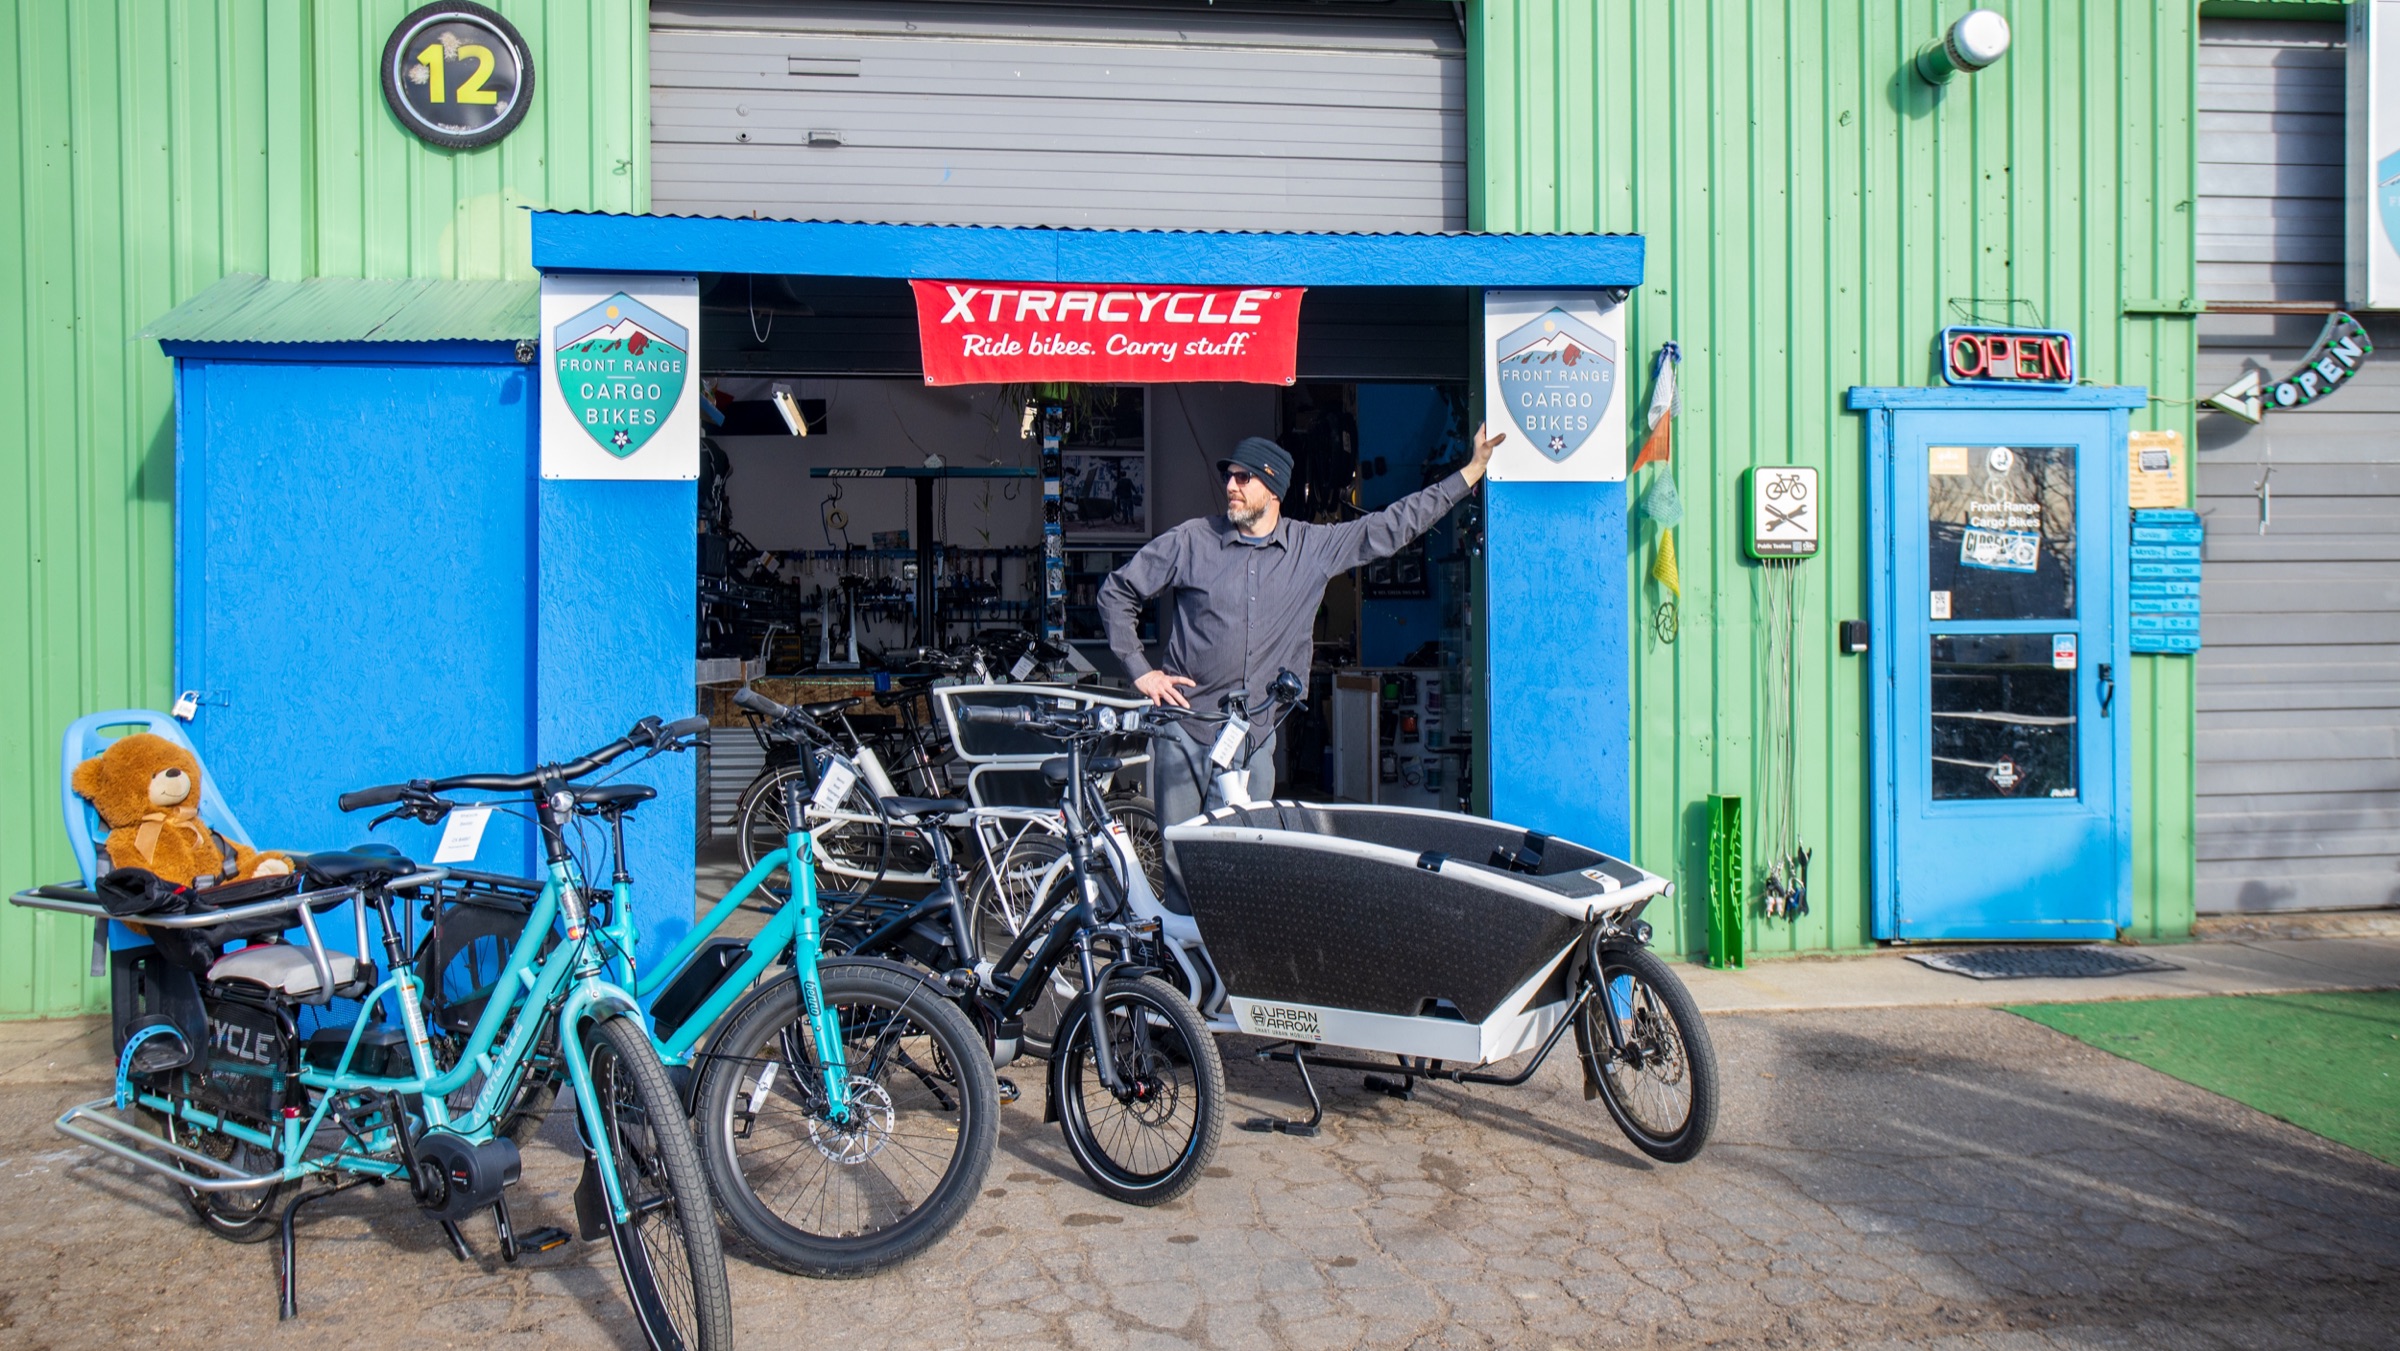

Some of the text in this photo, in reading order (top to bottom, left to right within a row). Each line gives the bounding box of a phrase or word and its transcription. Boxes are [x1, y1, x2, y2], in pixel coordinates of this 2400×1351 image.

[417, 44, 497, 104] 12
[962, 333, 1023, 357] Ride
[1028, 331, 1096, 356] bikes.
[1106, 333, 1177, 362] Carry
[1951, 334, 2071, 379] OPEN
[560, 359, 681, 372] FRONT RANGE
[2275, 336, 2363, 406] OPEN
[1502, 370, 1610, 382] FRONT RANGE
[581, 383, 661, 400] CARGO
[1521, 392, 1593, 407] CARGO
[586, 408, 657, 424] BIKES
[1526, 415, 1588, 430] BIKES
[1970, 501, 2041, 514] Front Range
[1970, 516, 2041, 529] Cargo Bikes
[804, 981, 821, 1016] benno
[1264, 1006, 1317, 1023] URBAN
